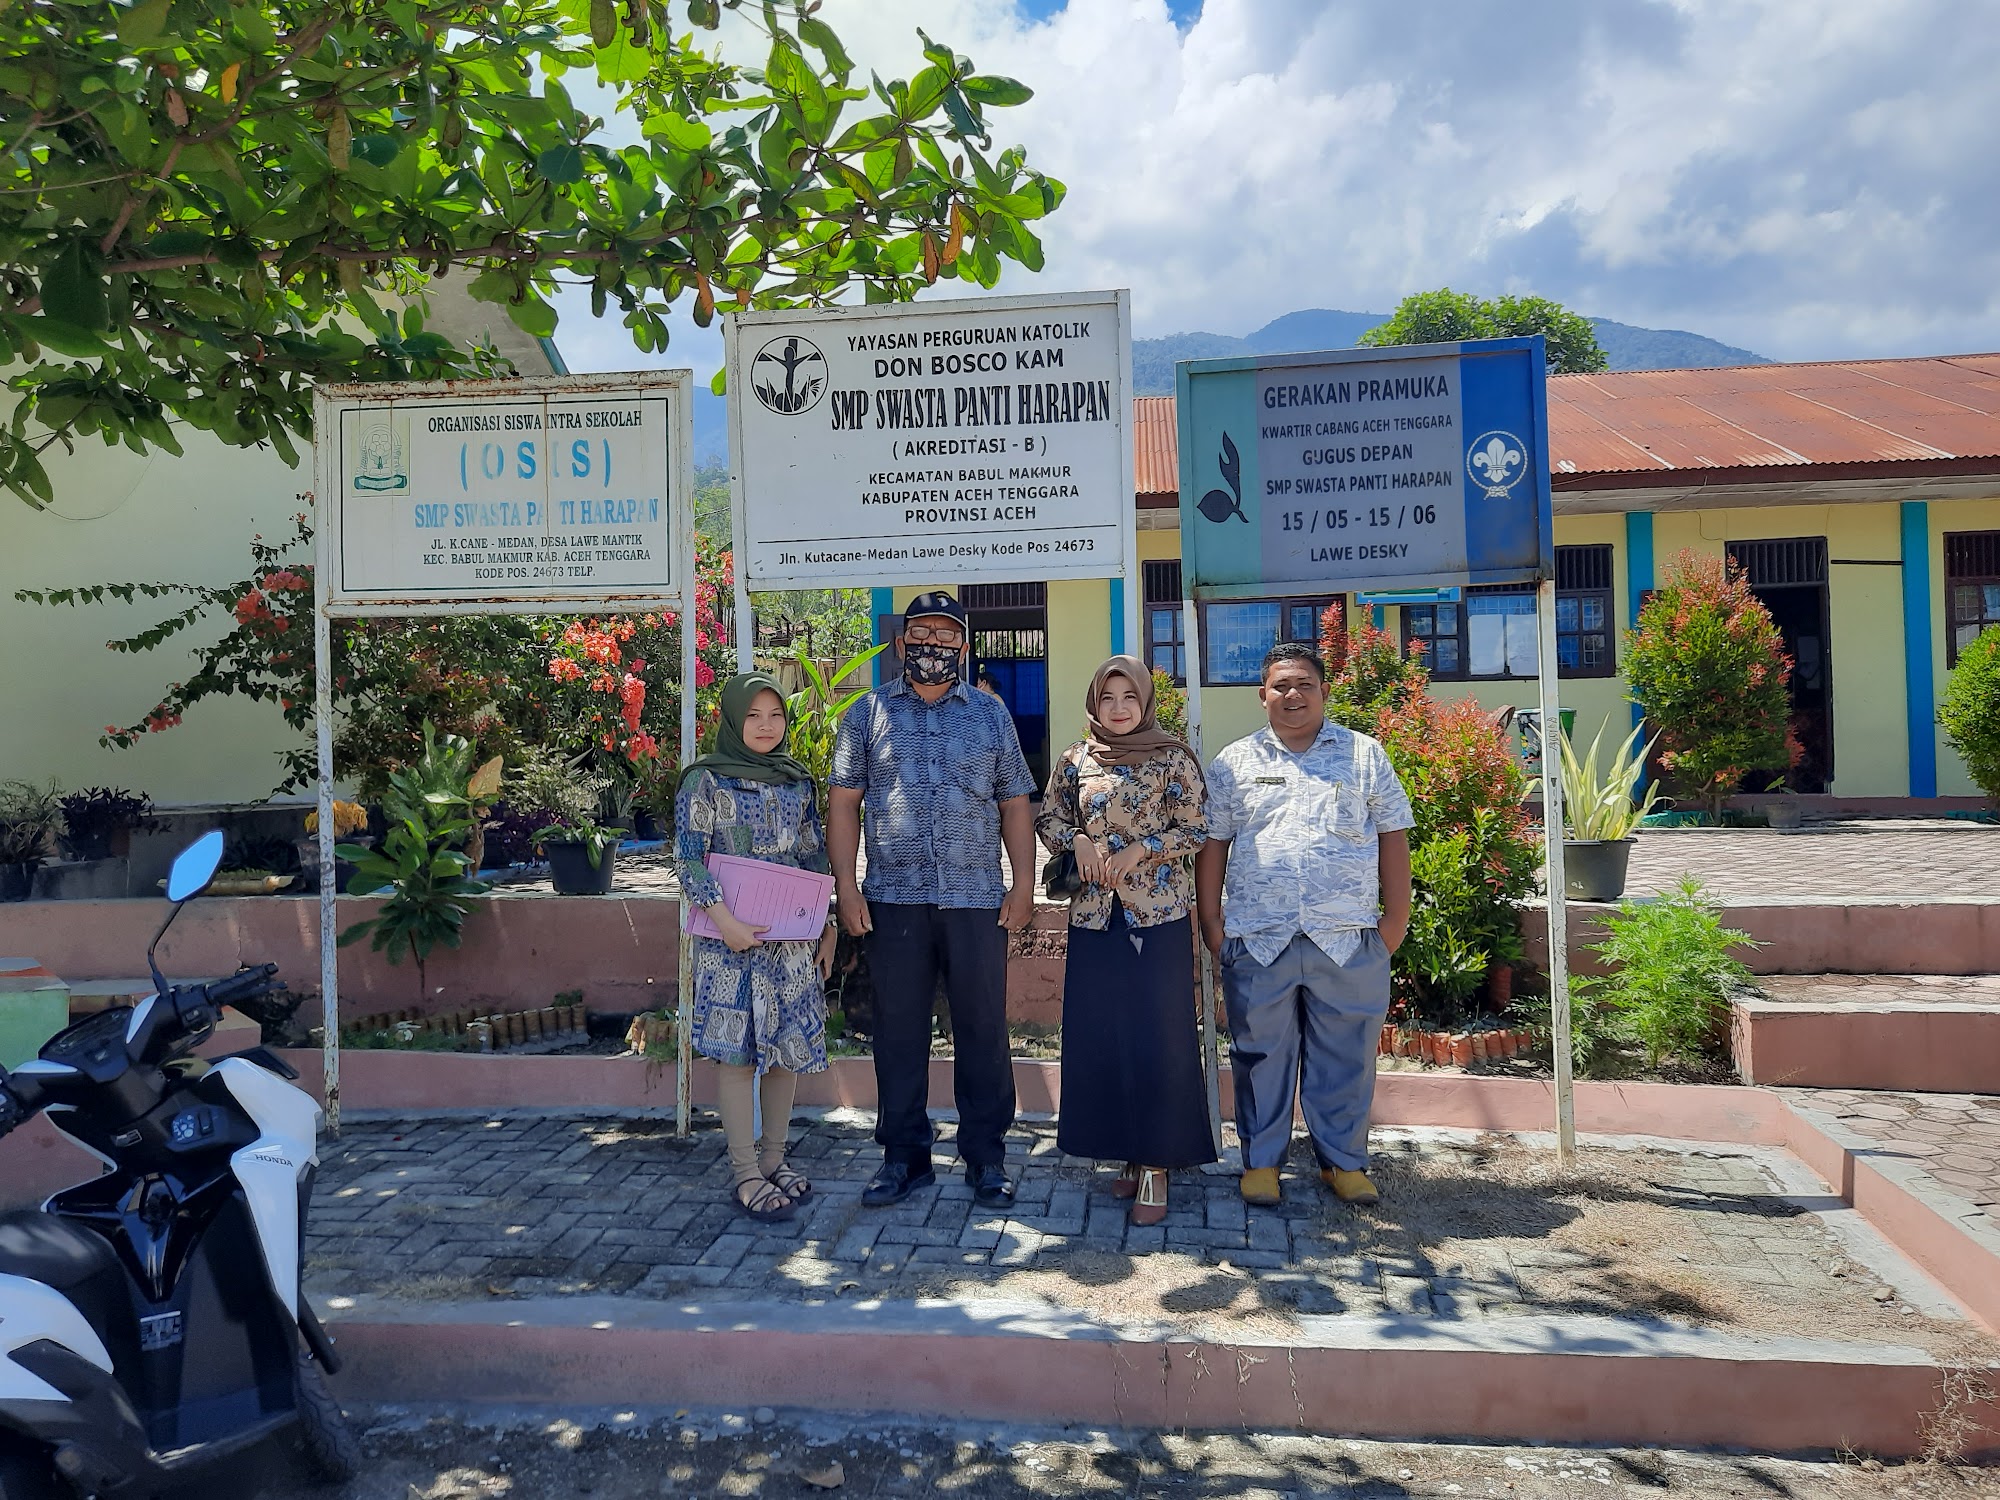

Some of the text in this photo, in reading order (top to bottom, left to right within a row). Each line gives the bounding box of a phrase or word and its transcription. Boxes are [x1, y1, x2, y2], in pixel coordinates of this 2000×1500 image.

[847, 321, 1091, 352] YAYASAN PERGURUAN KATOLIK
[874, 348, 1064, 379] DON BOSCO KAM
[1263, 375, 1449, 409] GERAKAN PRAMUKA
[831, 380, 1110, 431] SMP SWASTA PANTI HARAPAN
[428, 411, 642, 433] ORGANISASI SISWA INTRA SEKOLAH
[1262, 414, 1453, 439] KWARTIR CABANG ACEH TENGGARA
[904, 438, 1007, 457] AKREDITASI
[1302, 443, 1413, 466] GUGUS DEPAN
[869, 465, 1072, 485] KECAMATAN BABUL MAKMUR
[1266, 470, 1452, 496] SMP SWASTA PANTI HARAPAN
[862, 484, 1080, 505] KABUPATEN ACEH TENGGARA
[414, 498, 659, 529] SMP SWASTA PATI HARAPAN
[905, 506, 1037, 523] PROVINSI ACEH
[1282, 511, 1304, 531] 15
[1326, 509, 1348, 530] 05
[1369, 506, 1391, 528] 15
[1413, 504, 1436, 525] 06
[430, 538, 447, 550] JL.
[449, 537, 489, 550] K.CANE
[497, 536, 538, 550] MEDAN,
[540, 536, 568, 548] DESA
[570, 535, 599, 548] LAWE
[602, 534, 643, 546] MANTIK
[779, 539, 1095, 565] Jln. Kutacane-Medan Lawe Desky Kode Pos 24673
[1310, 543, 1409, 562] LAWE DESKY
[423, 549, 651, 565] KEC. BABUL MAKMUR KAB. ACEH TENGGARA
[474, 565, 596, 579] KODE POS. 24673 TELP.
[254, 1153, 294, 1168] HONDA
